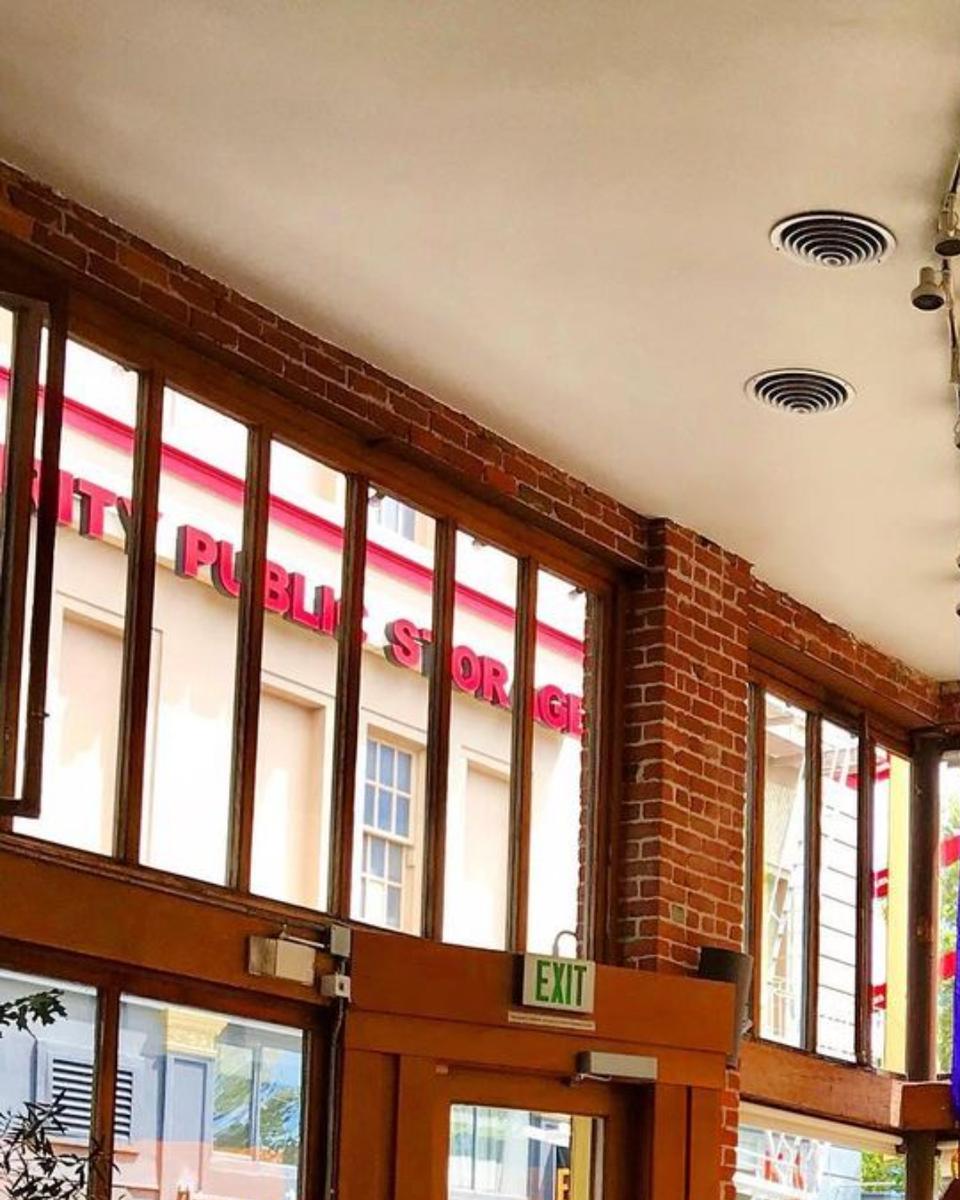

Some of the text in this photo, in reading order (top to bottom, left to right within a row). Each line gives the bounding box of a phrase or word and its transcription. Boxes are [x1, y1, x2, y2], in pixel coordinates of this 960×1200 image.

[175, 524, 368, 645] PUBLI
[384, 618, 584, 736] SORGE
[536, 959, 587, 1007] EXIT
